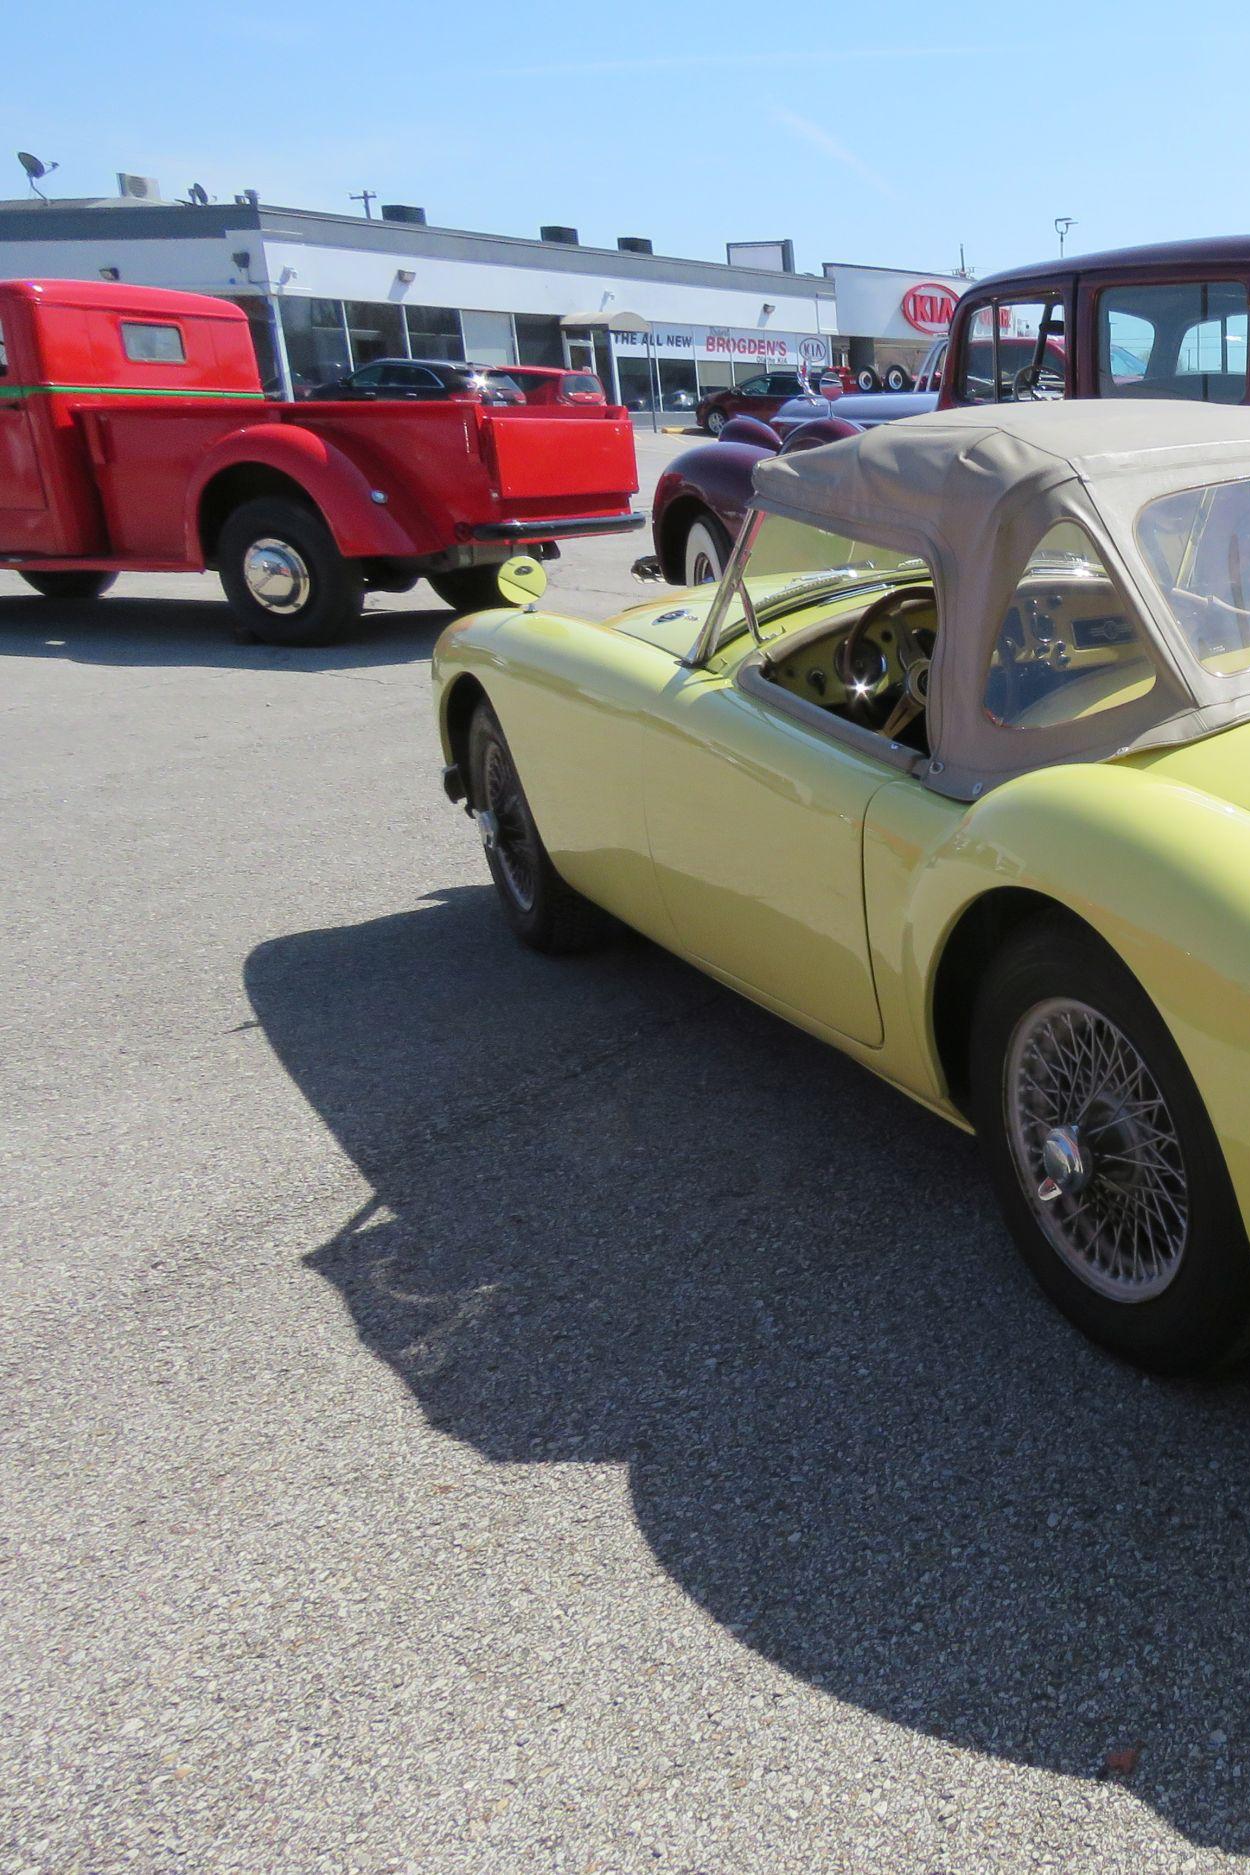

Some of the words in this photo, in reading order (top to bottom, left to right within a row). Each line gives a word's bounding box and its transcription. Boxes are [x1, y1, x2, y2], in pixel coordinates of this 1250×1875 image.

[913, 294, 953, 324] KIA
[613, 332, 637, 346] THE
[641, 332, 663, 347] ALL
[666, 334, 693, 348] NEW
[706, 335, 787, 357] BROGDEN'S
[803, 343, 823, 358] KIA
